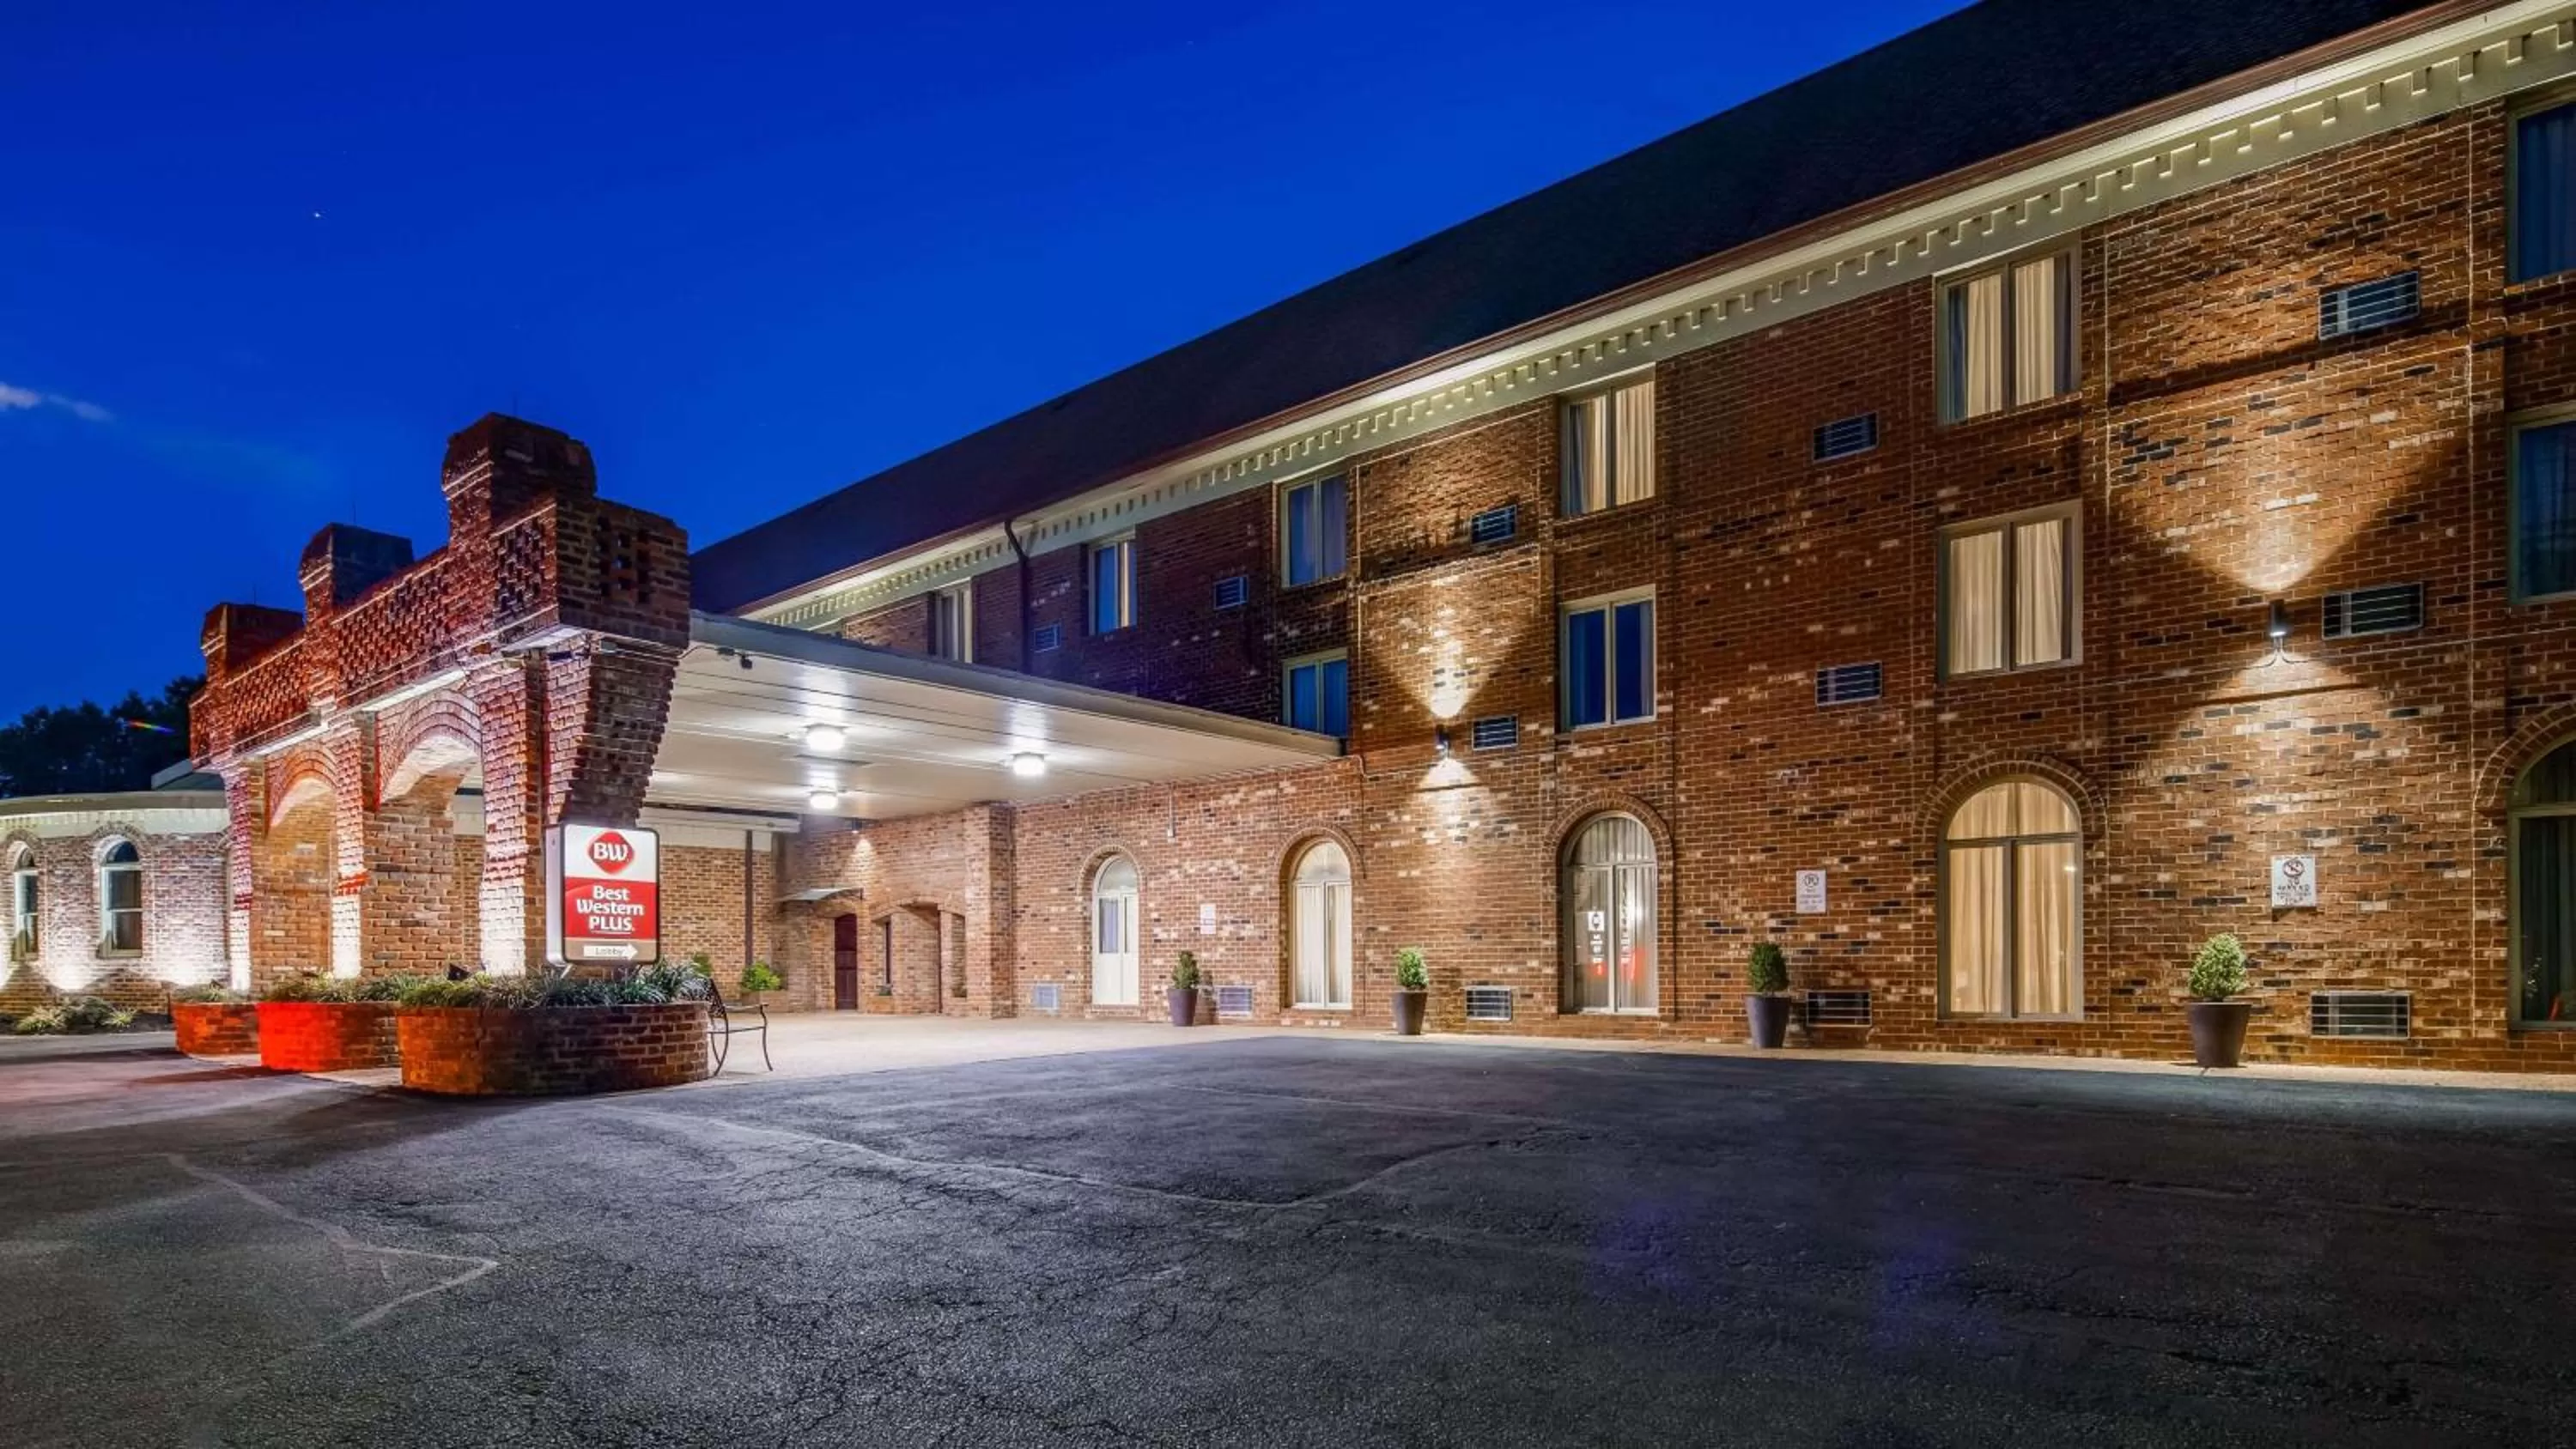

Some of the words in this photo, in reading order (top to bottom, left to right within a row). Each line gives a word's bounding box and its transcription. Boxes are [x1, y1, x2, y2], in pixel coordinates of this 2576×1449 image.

[593, 843, 627, 861] BW
[592, 885, 629, 900] Best
[576, 900, 644, 916] Western
[589, 916, 632, 931] PLUS
